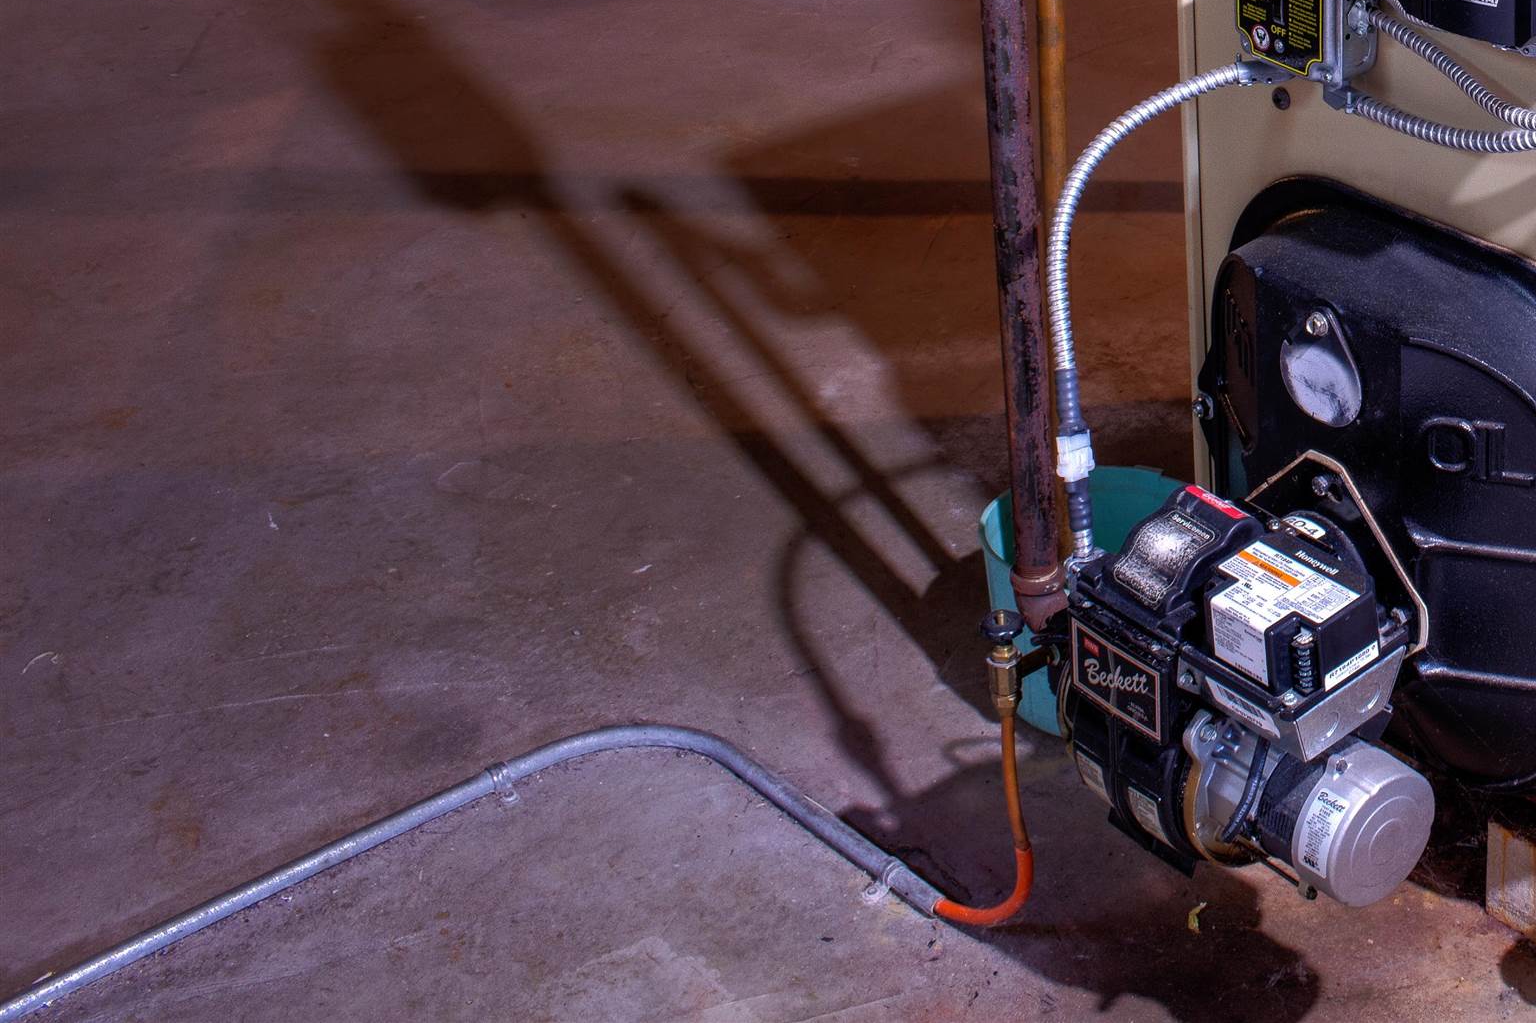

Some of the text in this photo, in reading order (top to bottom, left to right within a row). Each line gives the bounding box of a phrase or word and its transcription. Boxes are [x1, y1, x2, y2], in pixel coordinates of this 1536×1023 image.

[1271, 24, 1287, 37] OFF
[1294, 549, 1340, 576] Honeywell
[1084, 658, 1150, 694] Beckett
[1318, 791, 1346, 813] Beckett
